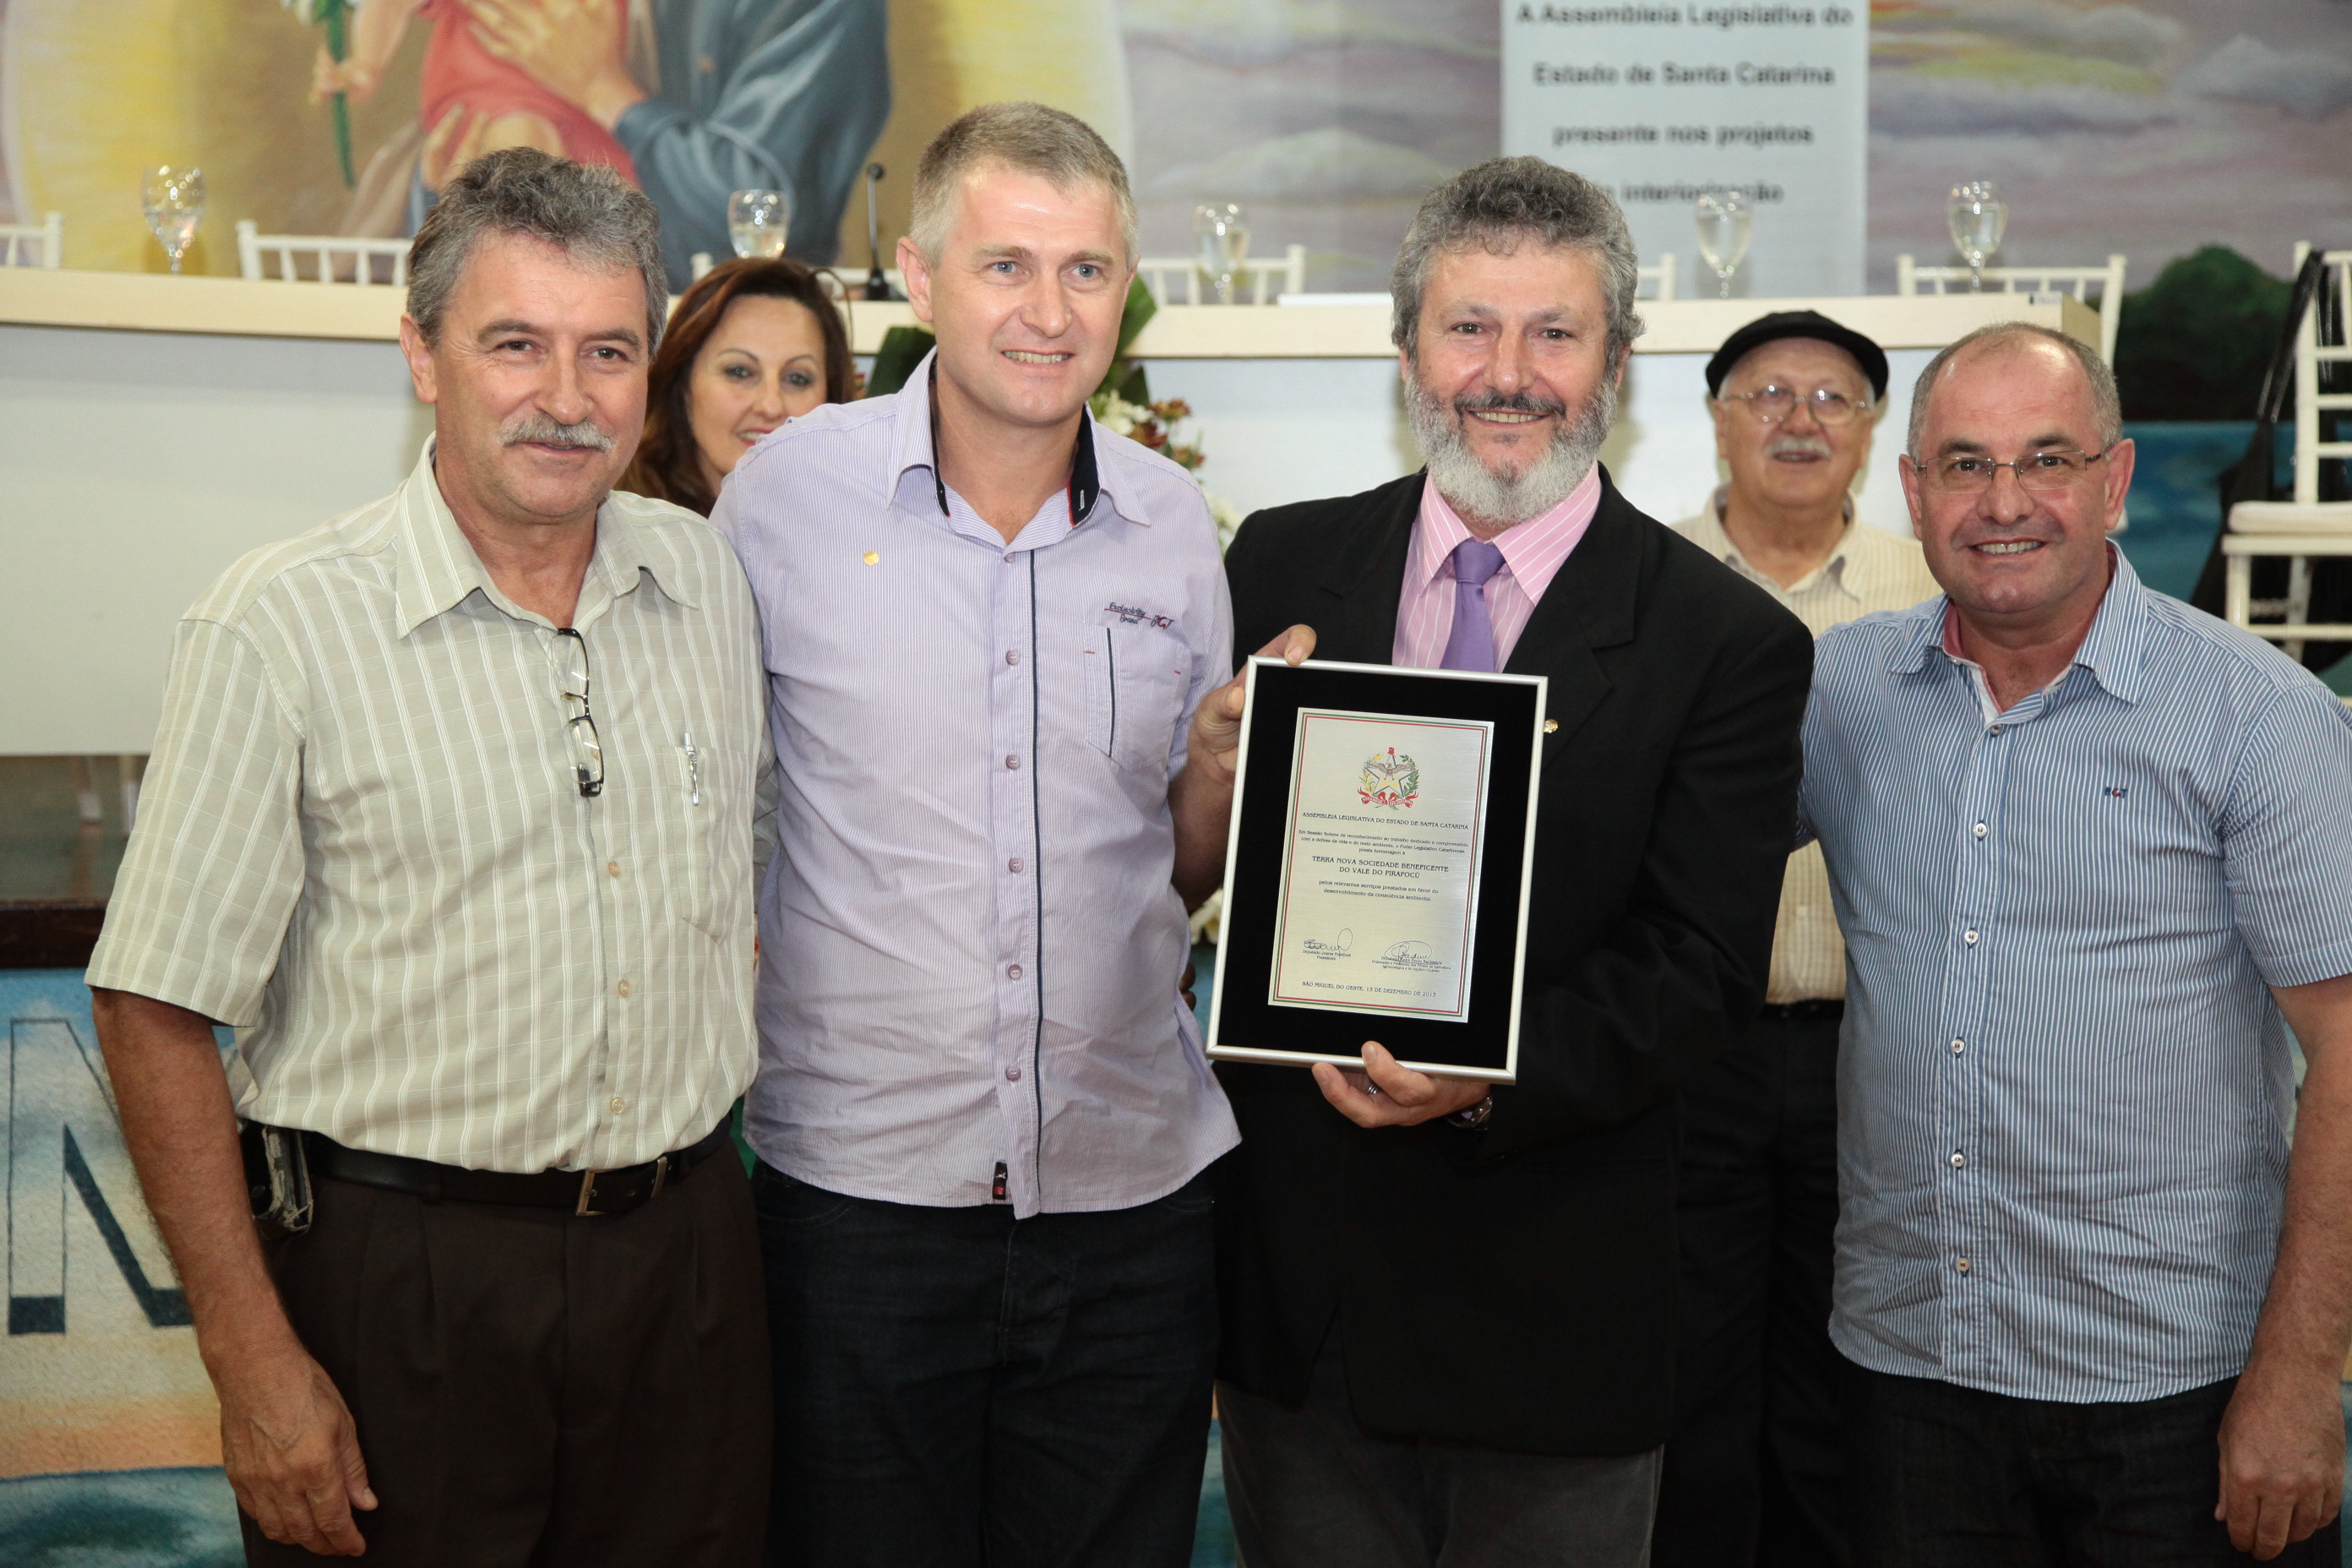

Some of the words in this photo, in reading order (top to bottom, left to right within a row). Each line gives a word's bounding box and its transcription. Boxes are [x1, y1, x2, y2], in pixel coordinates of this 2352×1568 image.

[1517, 7, 1538, 24] A
[1539, 6, 1682, 24] Assembleia
[1690, 6, 1816, 30] Legislativa
[1821, 6, 1854, 24] do
[1533, 62, 1620, 84] Estado
[1625, 63, 1654, 84] de
[1661, 62, 1731, 84] Santa
[1735, 62, 1836, 84] Catarina
[1552, 124, 1660, 146] presente
[1665, 127, 1708, 144] nos
[1716, 122, 1815, 149] projetos
[1338, 814, 1375, 823] LEGISLATIVA
[1401, 863, 1449, 872] BENEFICENTE
[1323, 888, 1366, 896] desenvolvimento
